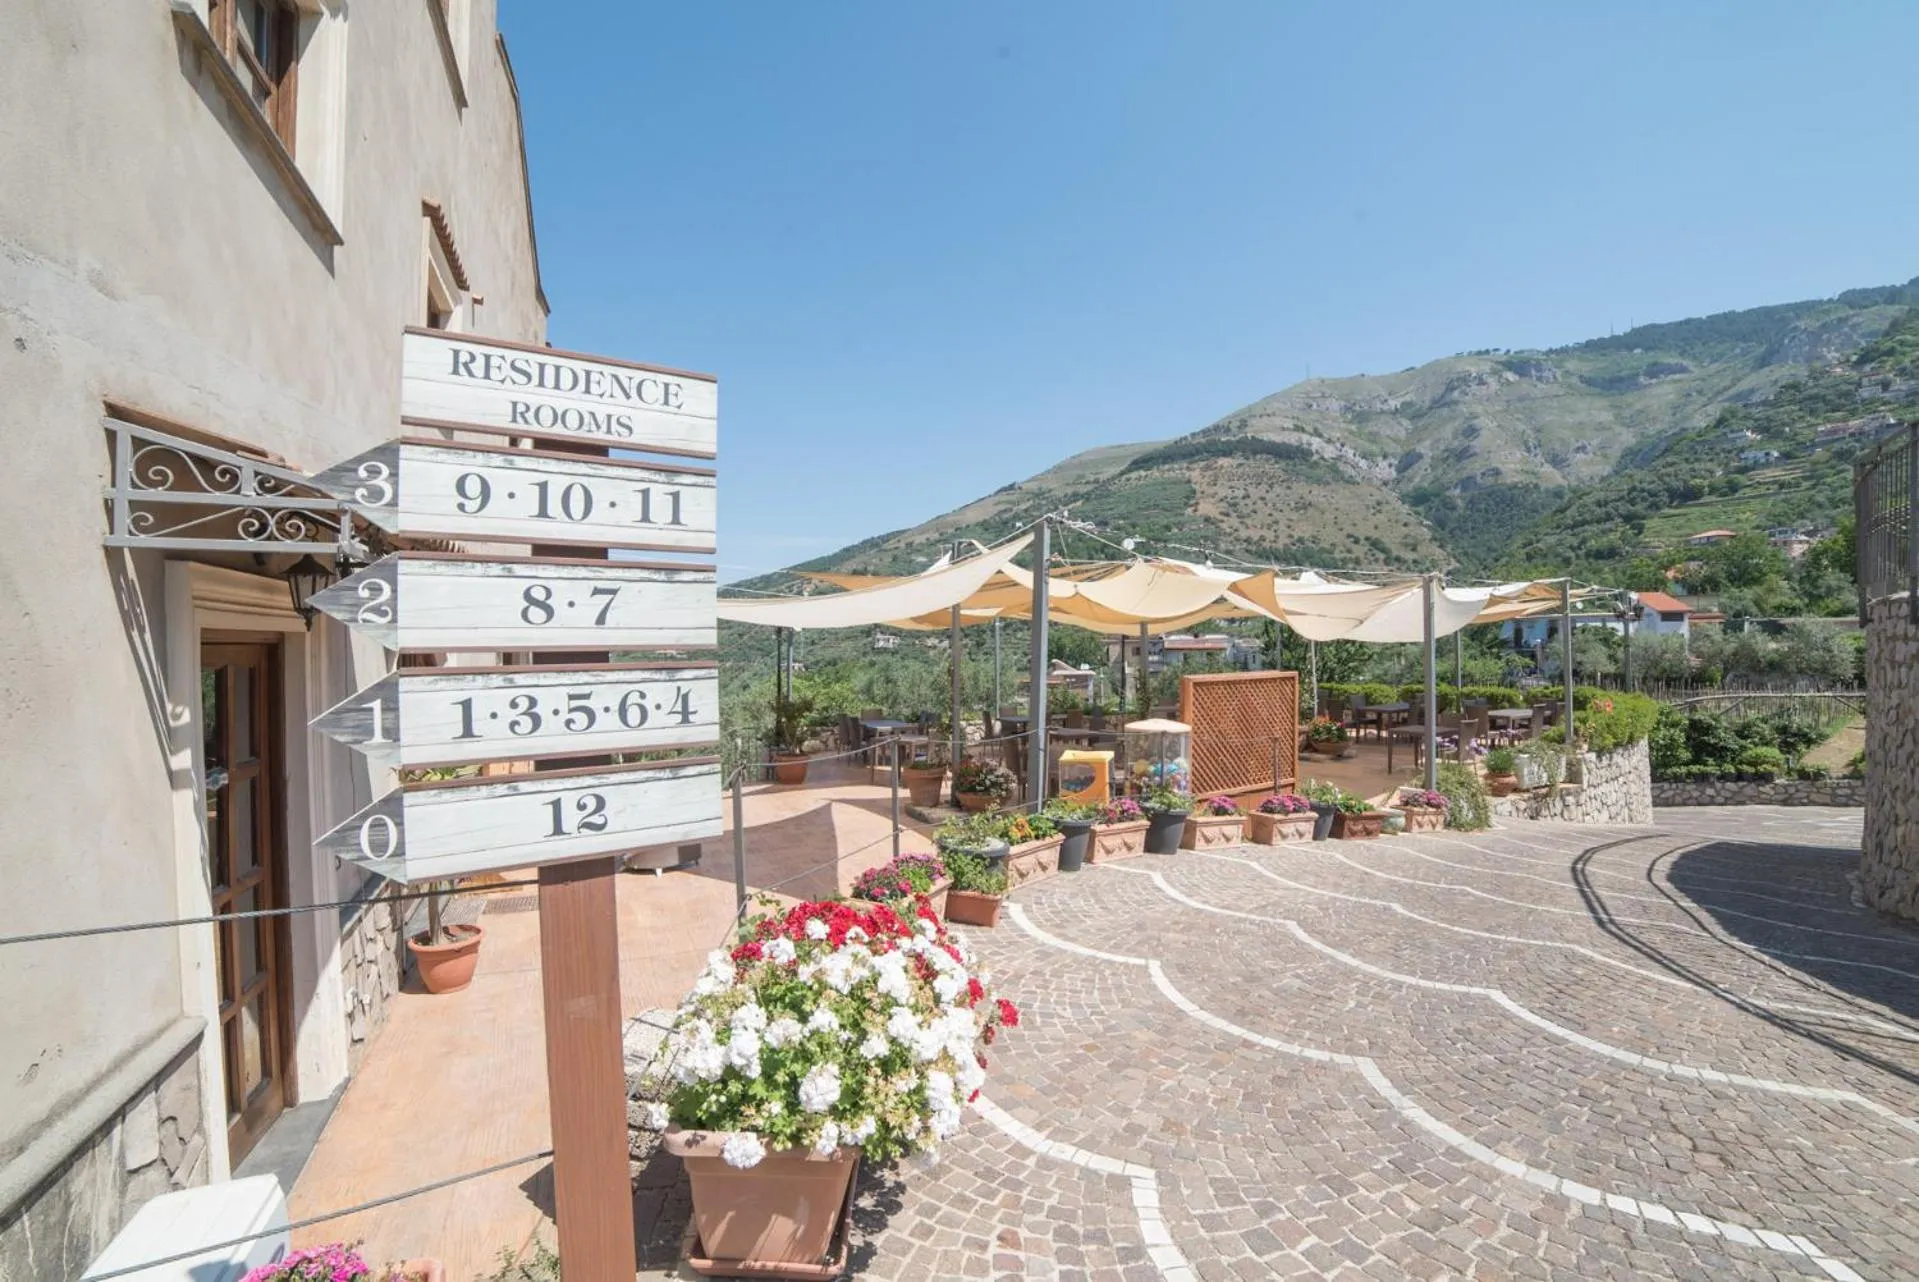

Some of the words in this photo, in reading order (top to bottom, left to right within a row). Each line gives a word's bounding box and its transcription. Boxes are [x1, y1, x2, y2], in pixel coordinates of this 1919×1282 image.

[449, 348, 684, 410] RESIDENCE
[509, 400, 634, 438] ROOMS
[355, 461, 394, 507] 3
[357, 578, 393, 624] 2
[361, 698, 393, 745] 1
[543, 793, 608, 838] 12
